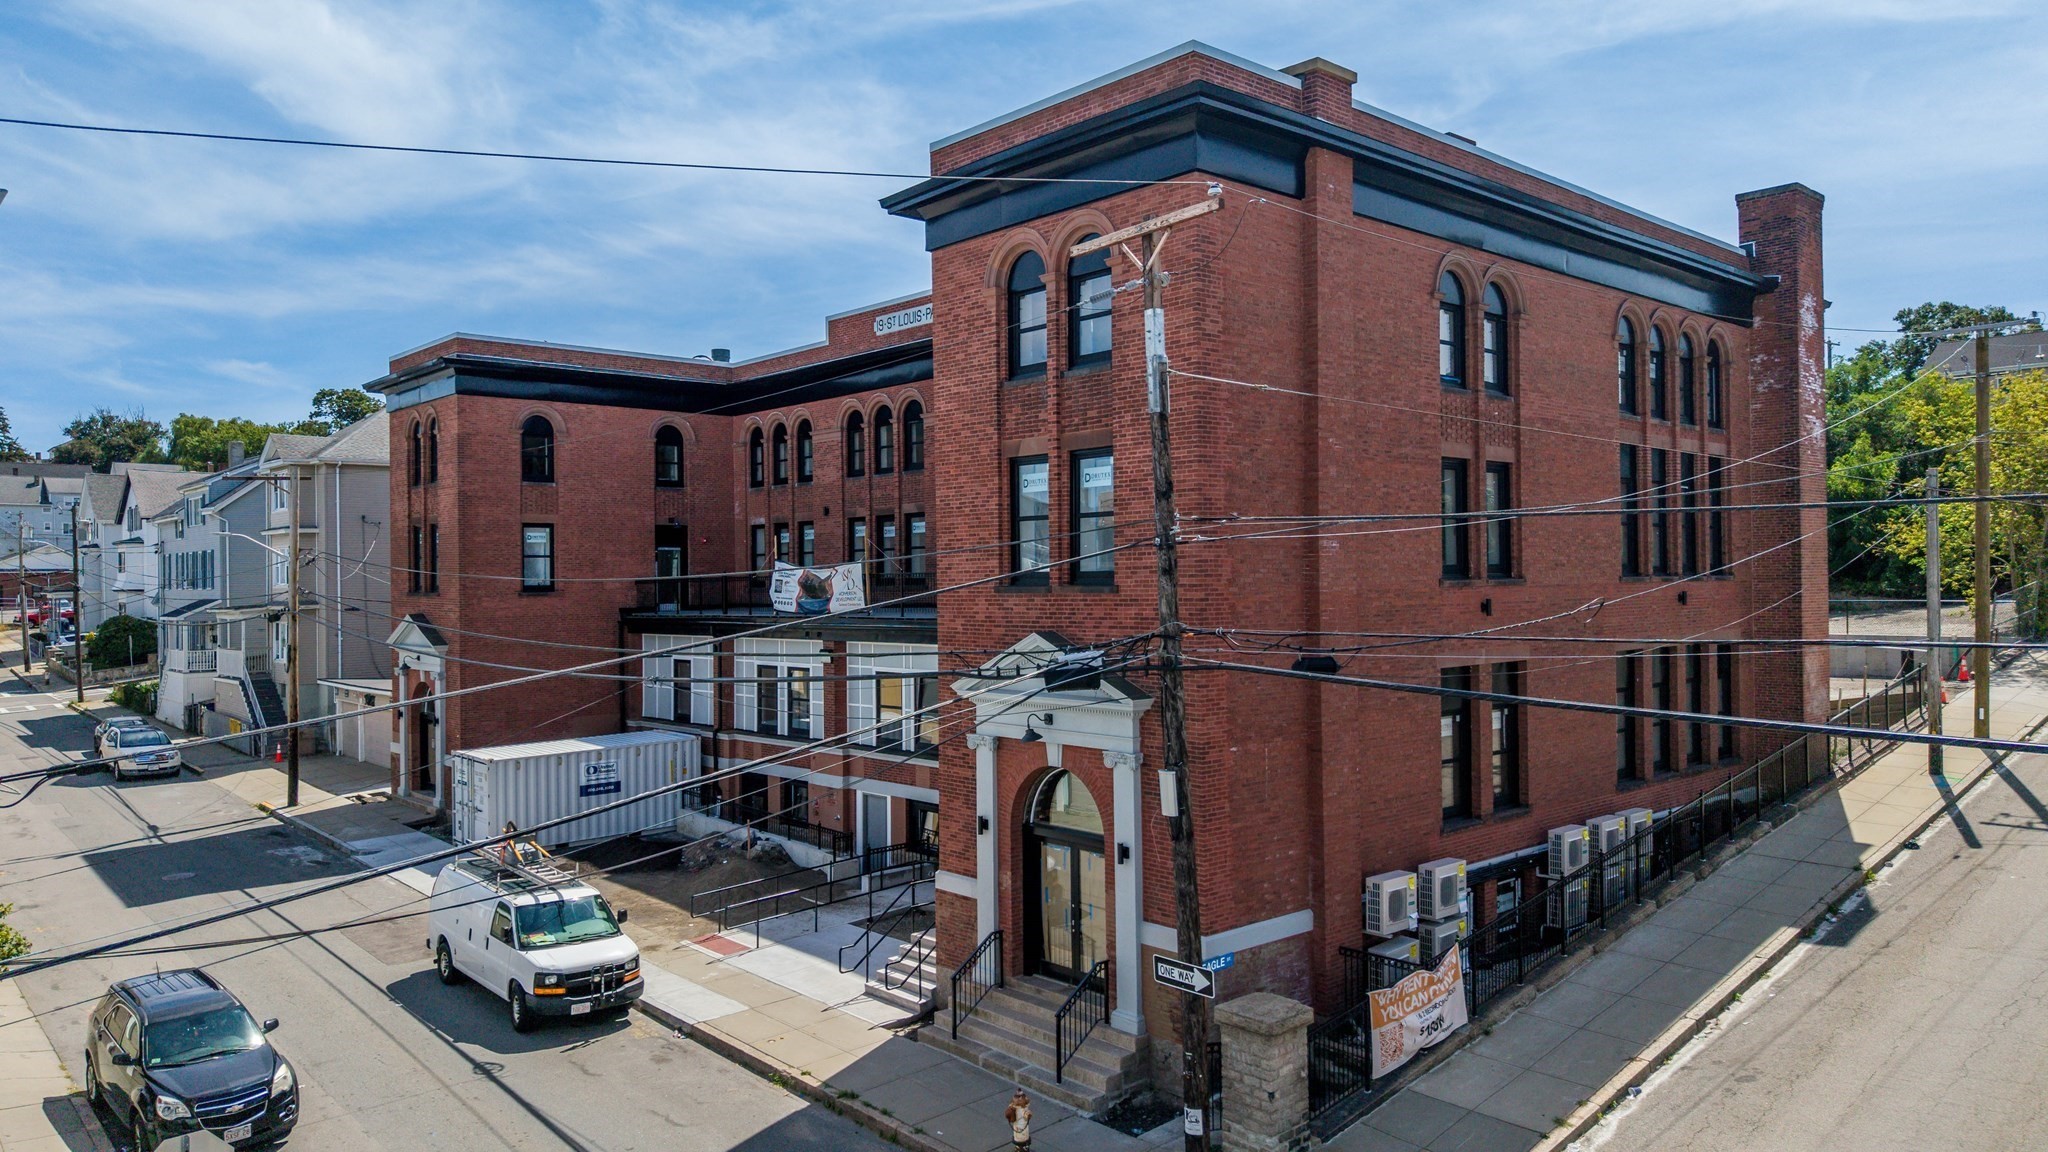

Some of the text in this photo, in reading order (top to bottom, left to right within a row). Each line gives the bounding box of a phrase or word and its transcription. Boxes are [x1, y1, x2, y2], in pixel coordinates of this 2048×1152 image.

[1159, 965, 1195, 984] ONE WAY
[1375, 985, 1403, 1006] WHY
[1403, 973, 1430, 996] RENT
[1381, 1001, 1403, 1022] YOU
[1403, 990, 1428, 1012] CAN
